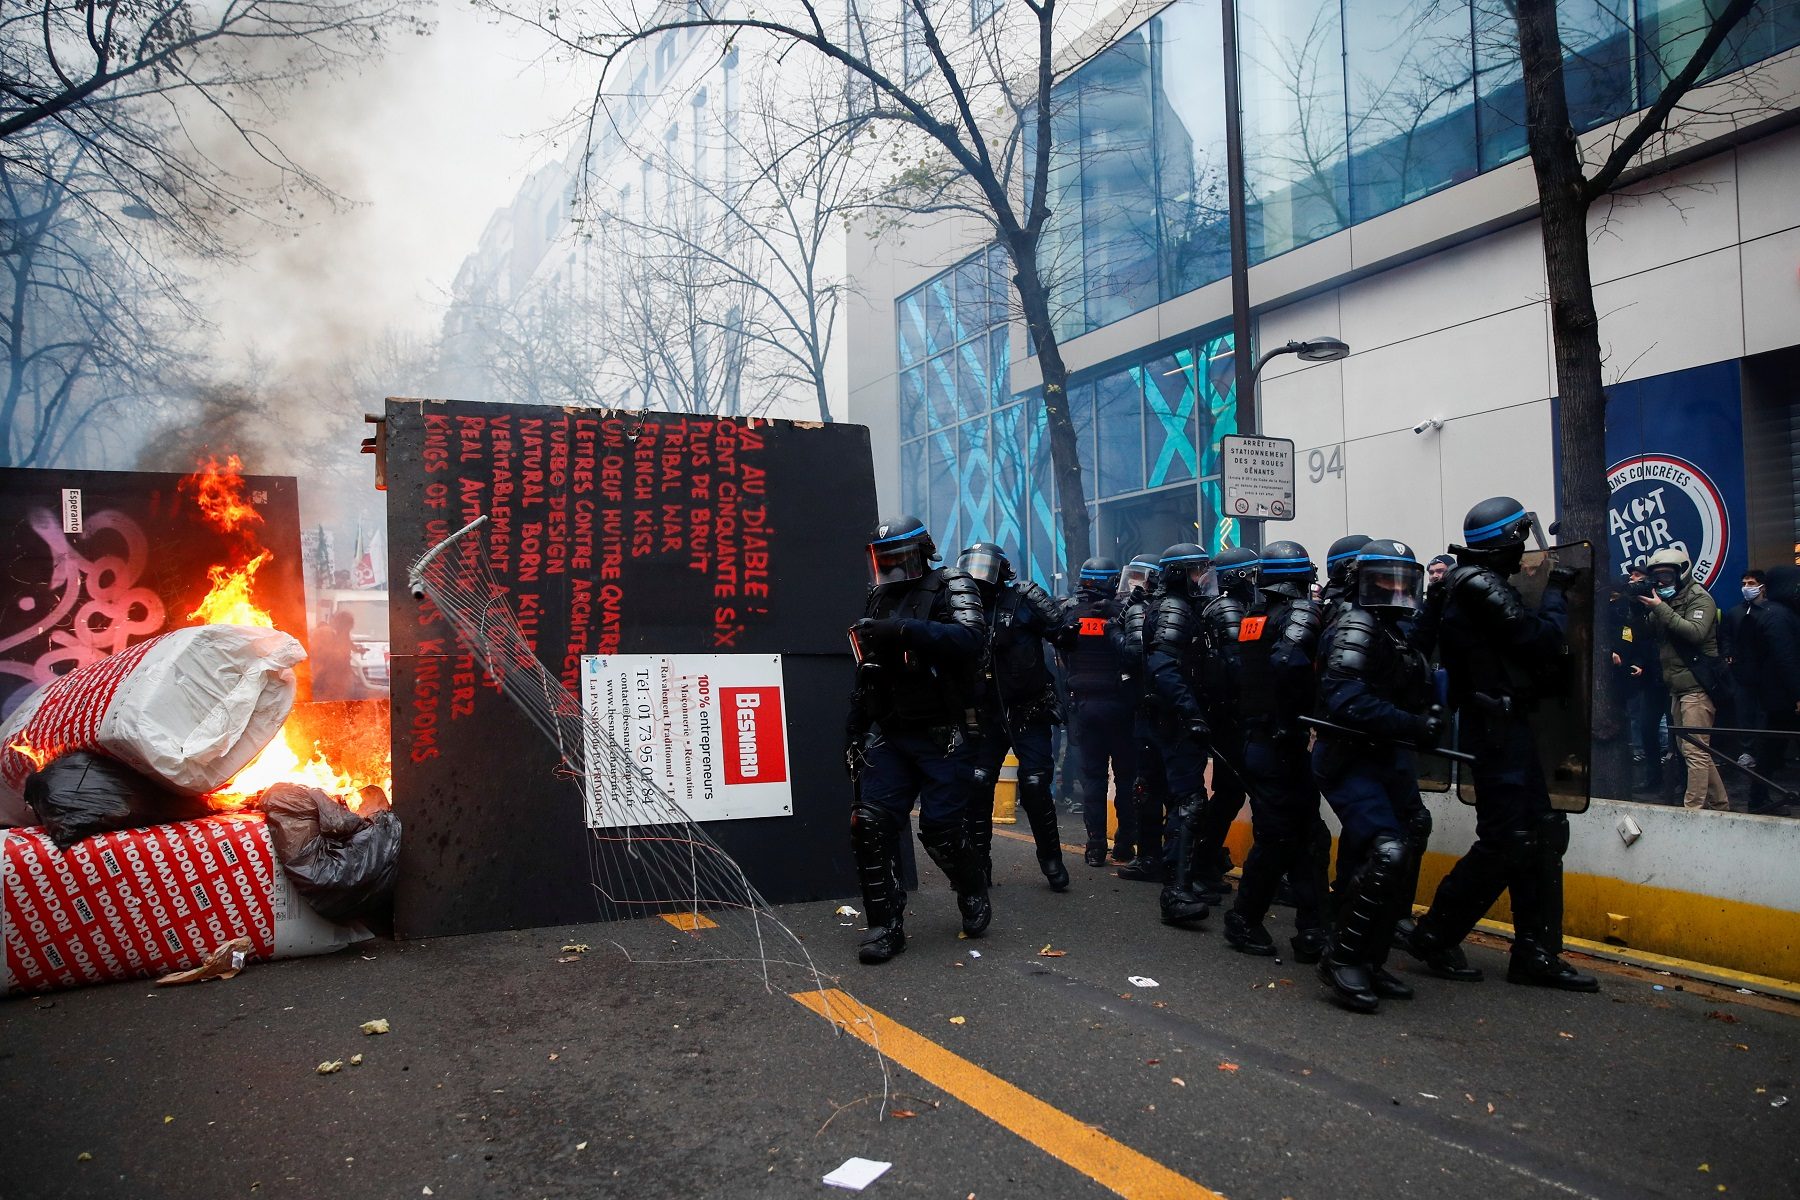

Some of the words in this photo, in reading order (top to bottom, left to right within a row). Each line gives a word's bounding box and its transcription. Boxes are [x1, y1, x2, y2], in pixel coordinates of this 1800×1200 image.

[456, 415, 487, 463] REAL
[550, 416, 569, 486] TURBO
[602, 419, 625, 448] UN
[690, 421, 713, 467] PLUS
[715, 420, 737, 476] CENT
[738, 419, 764, 452] VA
[1230, 447, 1288, 459] STATIONNEMENT
[1243, 439, 1264, 447] ARRÊT
[519, 418, 544, 508] NATURAL
[573, 419, 598, 494] LETTRES
[633, 421, 660, 500] FRENCH
[1234, 457, 1248, 465] DES
[1261, 460, 1284, 468] ROUES
[1308, 444, 1344, 484] 94
[1629, 465, 1691, 487] CONCRÈTES
[423, 483, 449, 509] OF
[601, 455, 625, 502] OEUF
[691, 473, 710, 499] DE
[741, 463, 766, 494] AU
[68, 491, 80, 532] Esperanto
[661, 504, 683, 552] WAR
[518, 522, 543, 582] BORN
[571, 499, 596, 569] CONTRE
[1619, 518, 1673, 558] FOR
[597, 584, 624, 656] QUATRE
[1244, 622, 1258, 635] 123
[590, 679, 598, 690] La
[661, 666, 671, 719] Ravalement
[638, 704, 651, 720] 01
[681, 683, 691, 737] Maçonnerie
[639, 725, 652, 743] 73
[640, 746, 653, 763] 95
[664, 721, 675, 778] Traditionnel
[684, 748, 694, 799] Rénovation
[699, 711, 713, 800] entrepreneurs
[642, 788, 655, 804] 84
[104, 851, 120, 873] roche
[222, 841, 237, 863] roche
[20, 845, 72, 933] ROCKWOOL
[123, 841, 171, 928] ROCKWOOL
[143, 834, 191, 918] ROCKWOOL
[195, 885, 210, 908] roche
[77, 898, 94, 920] roche
[95, 886, 144, 968] ROCKWOOL
[116, 877, 163, 961] ROCKWOOL
[232, 866, 274, 947] ROCKWOOL
[46, 944, 64, 966] roche
[167, 929, 182, 950] roche
